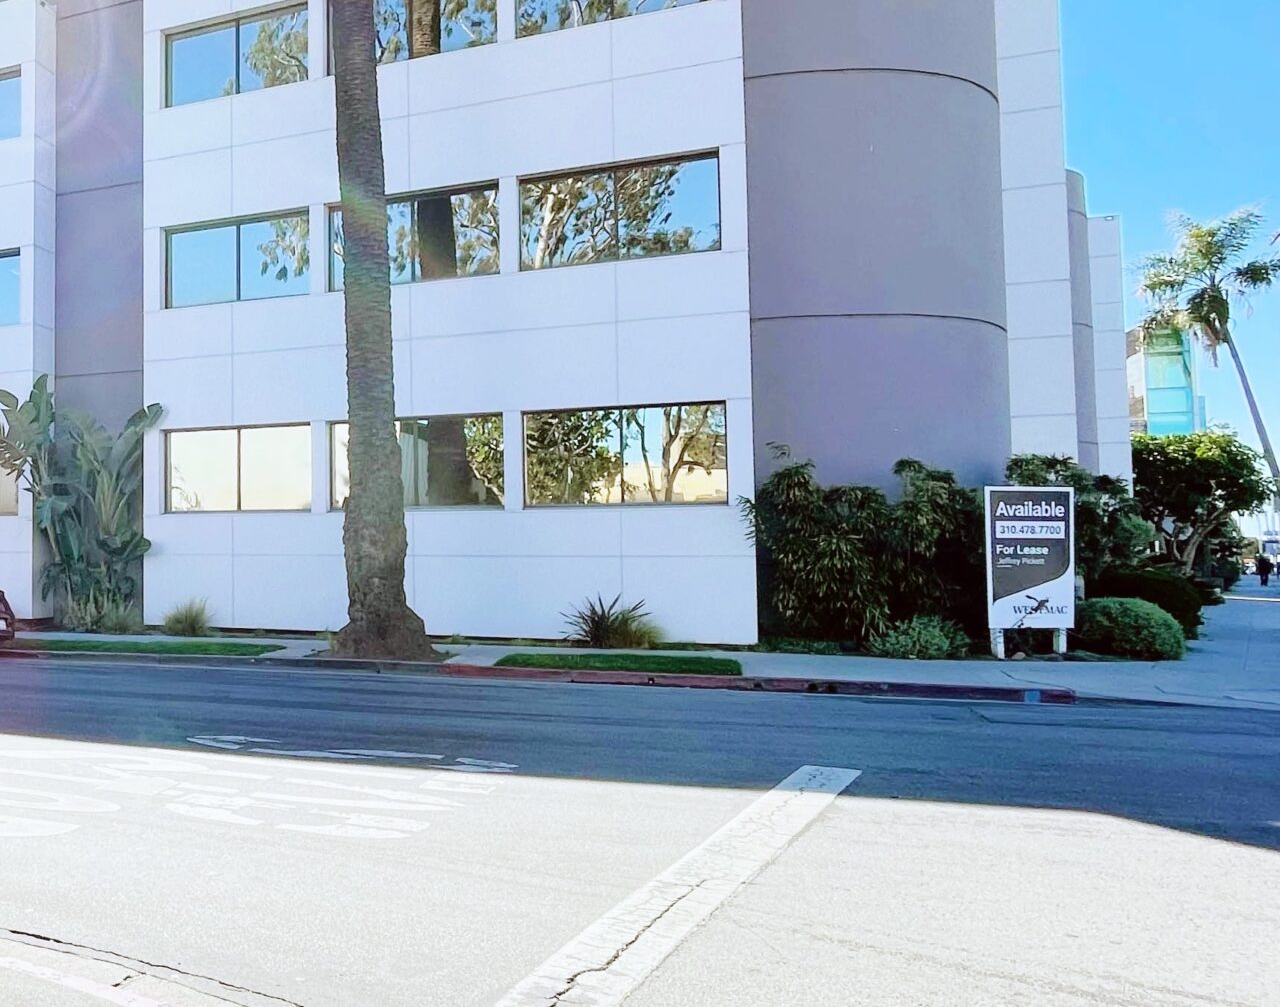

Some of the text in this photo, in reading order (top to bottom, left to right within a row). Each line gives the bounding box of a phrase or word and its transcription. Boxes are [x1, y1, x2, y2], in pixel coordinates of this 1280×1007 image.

[995, 501, 1065, 517] Available
[1000, 525, 1062, 535] 310.478.7700
[996, 544, 1049, 555] For Lease
